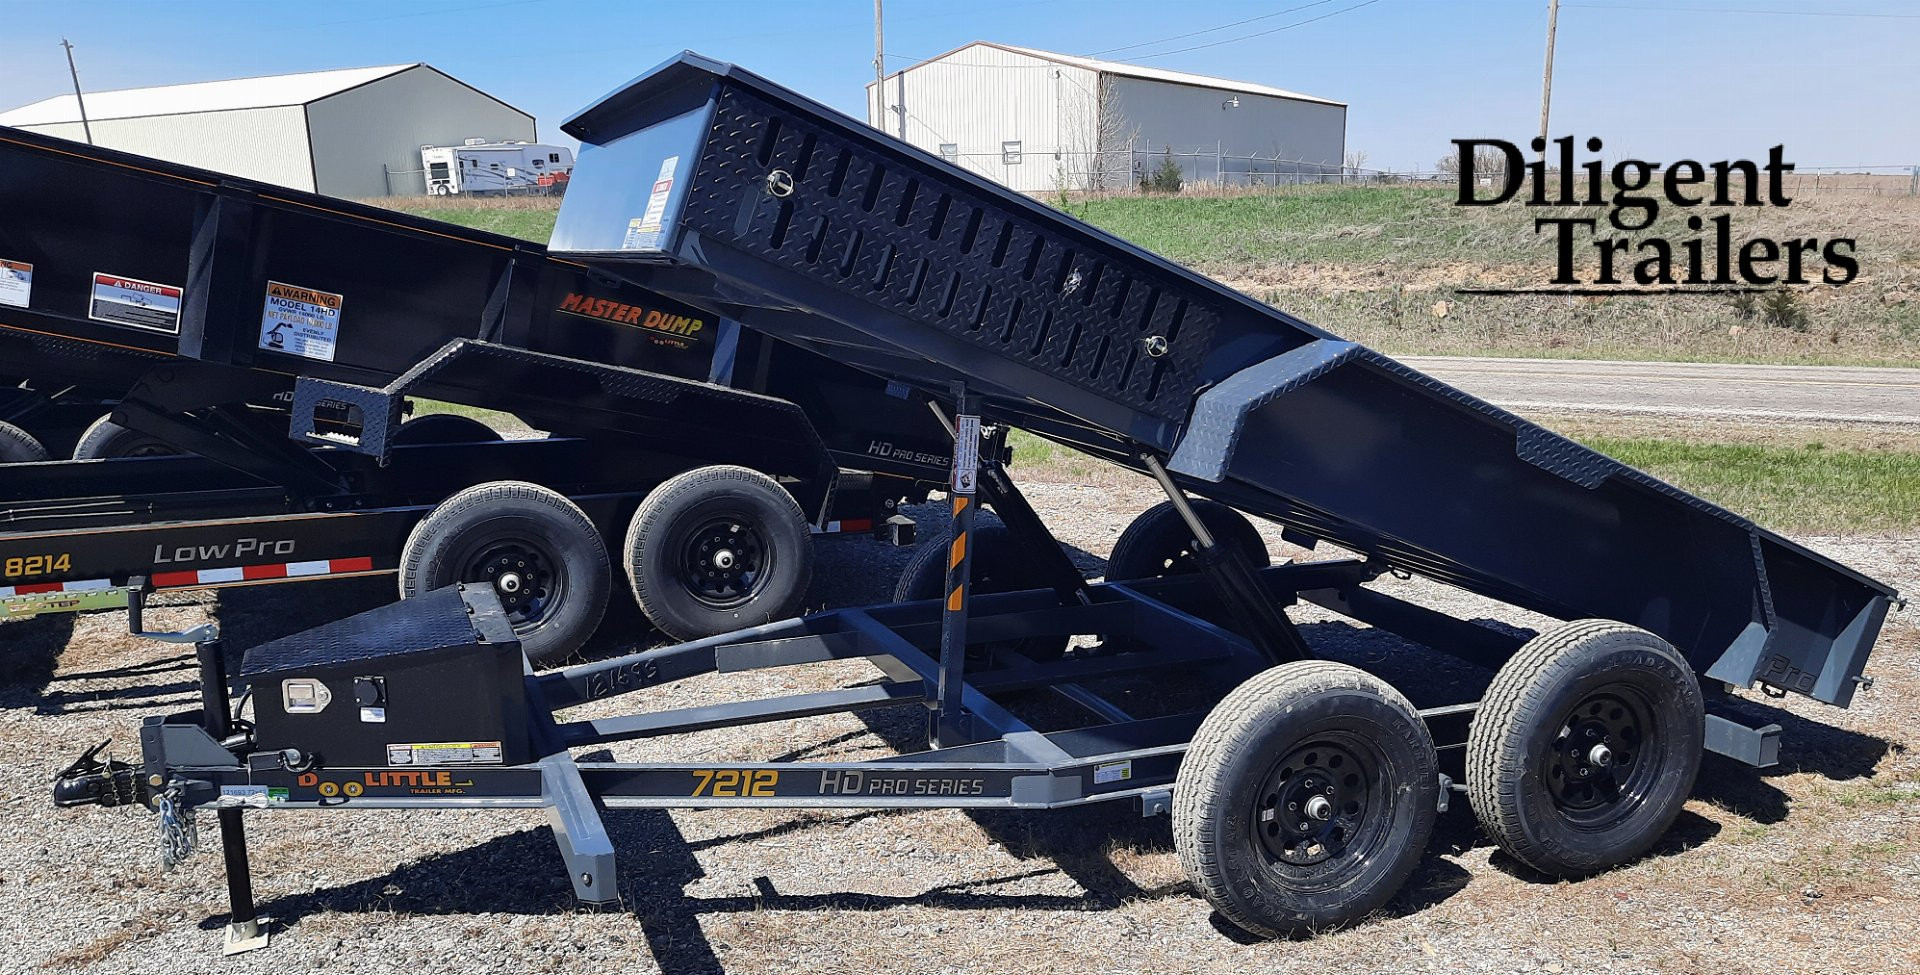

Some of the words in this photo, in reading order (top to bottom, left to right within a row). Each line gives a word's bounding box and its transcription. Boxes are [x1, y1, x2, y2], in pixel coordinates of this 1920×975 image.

[124, 282, 162, 294] DANGER
[283, 287, 336, 307] WARNING
[270, 297, 307, 311] MODEL
[310, 305, 336, 317] 14HD
[560, 292, 642, 325] MASTER
[643, 309, 703, 336] DUMP
[868, 440, 893, 456] HD
[892, 448, 914, 460] PRO
[914, 452, 950, 466] SERIES
[4, 553, 72, 578] 8214
[1762, 653, 1819, 693] Pro
[691, 770, 778, 797] 7212
[818, 770, 862, 794] HD
[868, 779, 909, 795] PRO
[913, 779, 985, 796] SERIES
